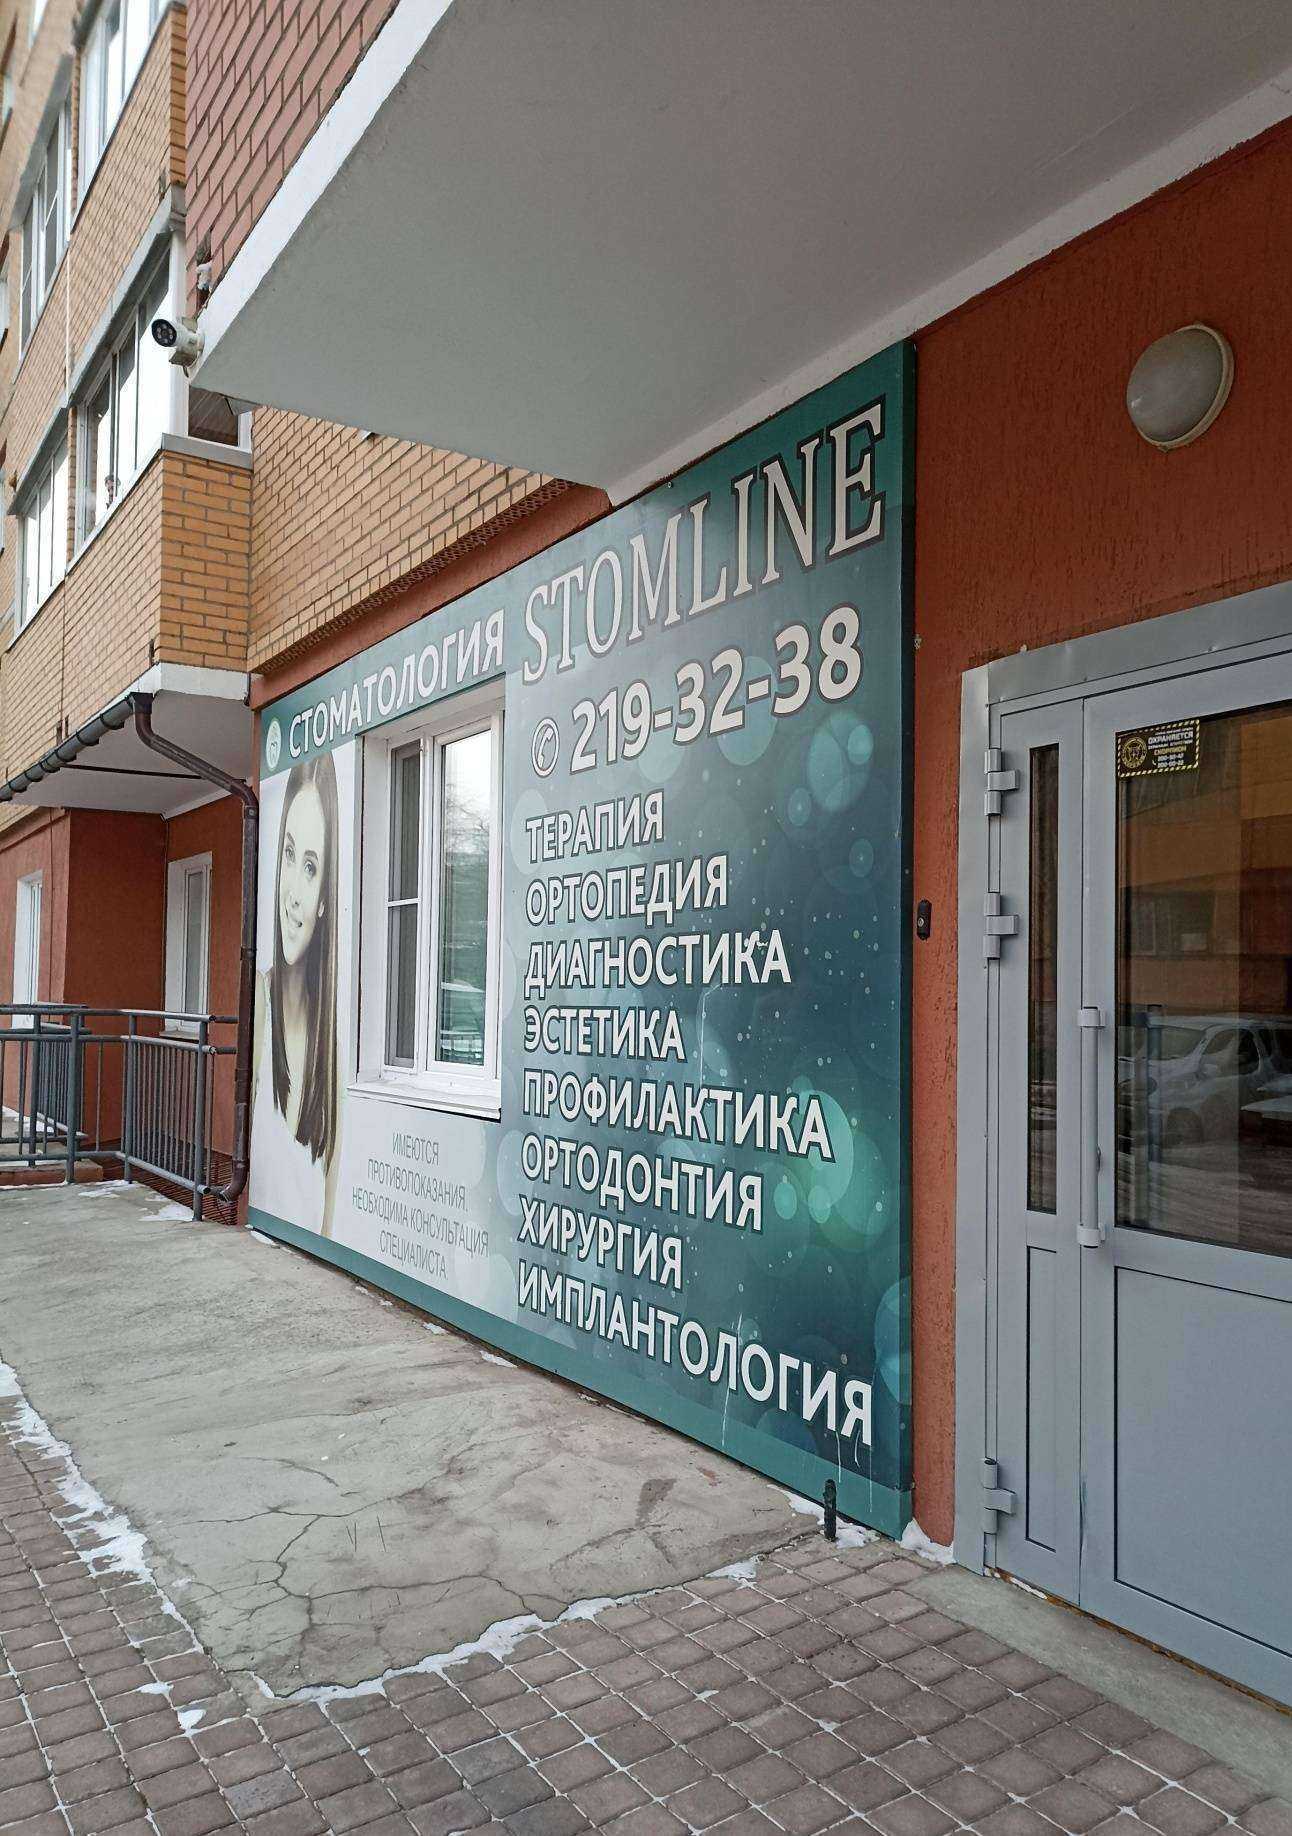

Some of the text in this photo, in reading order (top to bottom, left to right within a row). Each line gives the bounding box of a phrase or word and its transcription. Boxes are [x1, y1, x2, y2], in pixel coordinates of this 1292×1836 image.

[522, 400, 884, 684] STOMLINE
[289, 608, 505, 758] СТОМАТОЛОГИЯ
[570, 605, 862, 773] 219-32-38
[525, 790, 664, 863] ТЕРАПИЯ
[525, 853, 728, 927] ОРТОПЕДИЯ
[524, 929, 792, 999] ДИАГНОСТИКА
[523, 1006, 687, 1062] ЭСТЕТИКА
[392, 1132, 439, 1166] ИМЕЮТСЯ
[522, 1069, 834, 1161] ПРОФИЛАКТИКА
[352, 1186, 489, 1259] НЕОБХОДИМА КОНСУЛЬТАЦИЯ
[521, 1133, 764, 1232] ОРТОДОНТИЯ
[518, 1195, 682, 1290] ХИРУРГИЯ
[518, 1259, 874, 1446] ИМПЛАНТОЛОГИЯ
